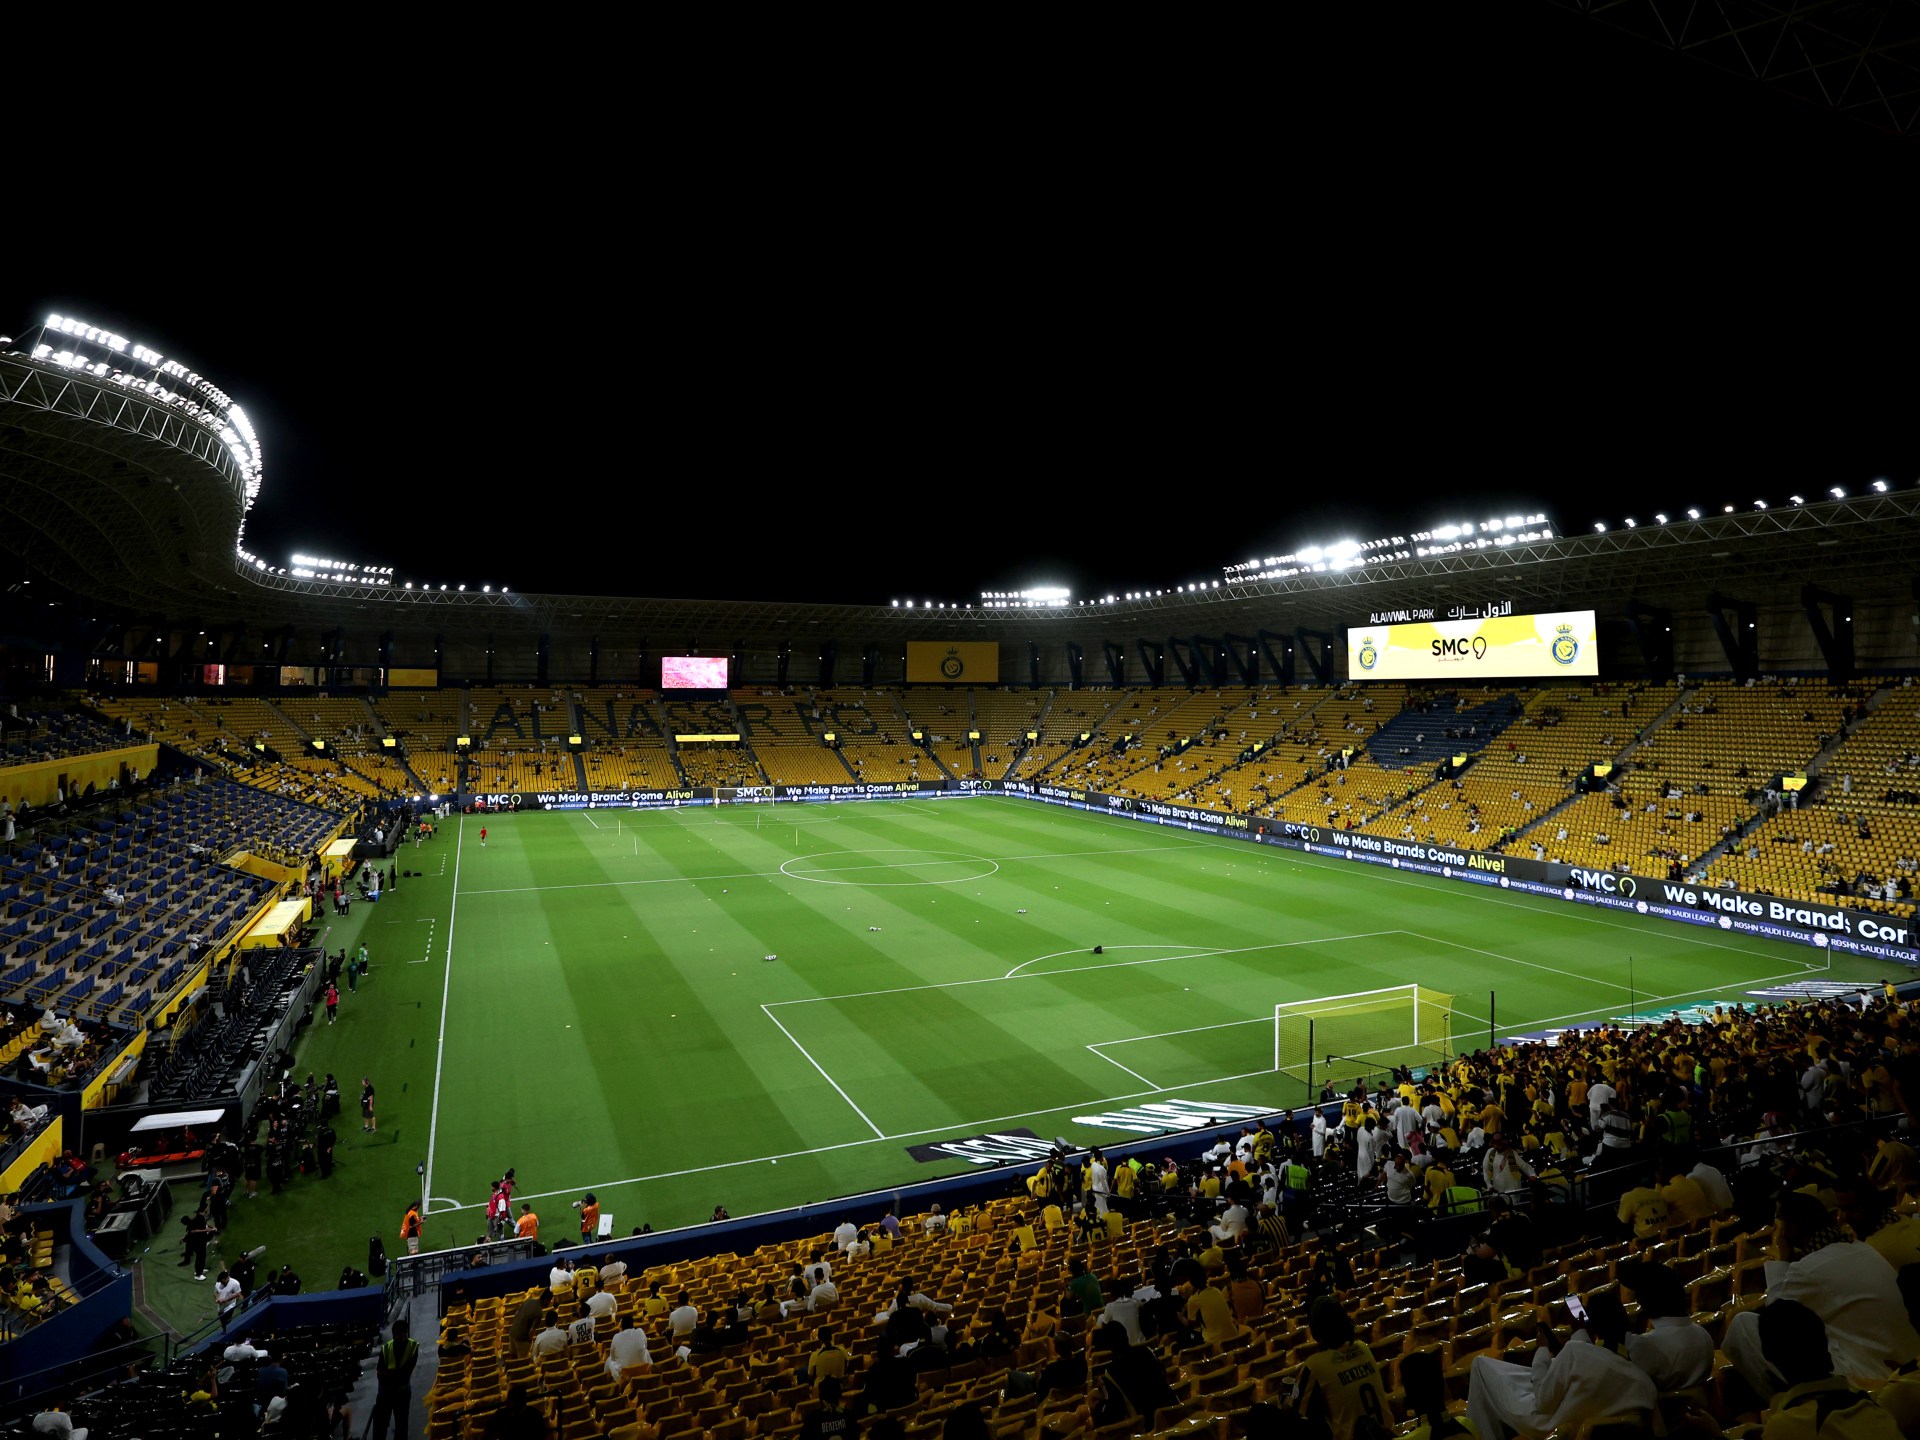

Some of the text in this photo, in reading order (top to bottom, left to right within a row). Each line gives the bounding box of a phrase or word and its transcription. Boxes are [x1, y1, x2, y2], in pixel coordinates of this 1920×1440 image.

[1370, 609, 1435, 623] ALAWWAL PARK
[1447, 601, 1512, 620] الأول بارك
[1432, 638, 1469, 656] SMC
[537, 790, 694, 803] We Make Brands Come Alive!
[736, 787, 762, 798] SMC
[786, 787, 802, 796] We
[804, 786, 830, 795] Make
[867, 784, 894, 792] Come
[895, 783, 920, 791] Alive!
[1003, 782, 1018, 790] We
[1054, 789, 1070, 798] Come
[475, 795, 509, 805] SMC
[1152, 804, 1171, 815] Make
[1200, 811, 1223, 824] Come
[1224, 816, 1248, 829] Alive!
[1223, 829, 1249, 838] RIYADH
[1332, 833, 1505, 873] We Make Brands Come Alive!
[1414, 863, 1426, 871] SAUDI
[1452, 870, 1498, 883] ROSHN SAUDI LEAGUE
[1570, 868, 1616, 892] SMC
[1510, 880, 1562, 896] ROSHN SAUDI LEAGUE
[1575, 892, 1634, 909] ROSHN SAUDI LEAGUE
[1649, 906, 1716, 924] ROSHN SAUDI LEAGUE
[1663, 885, 1697, 905] We
[1702, 891, 1763, 916] Make
[1769, 901, 1851, 934] Brands
[1734, 921, 1811, 942] ROSHN SAUDI LEAGUE
[1830, 938, 1918, 962] ROSHN SAUDI LEAGUE
[583, 1278, 590, 1288] 9
